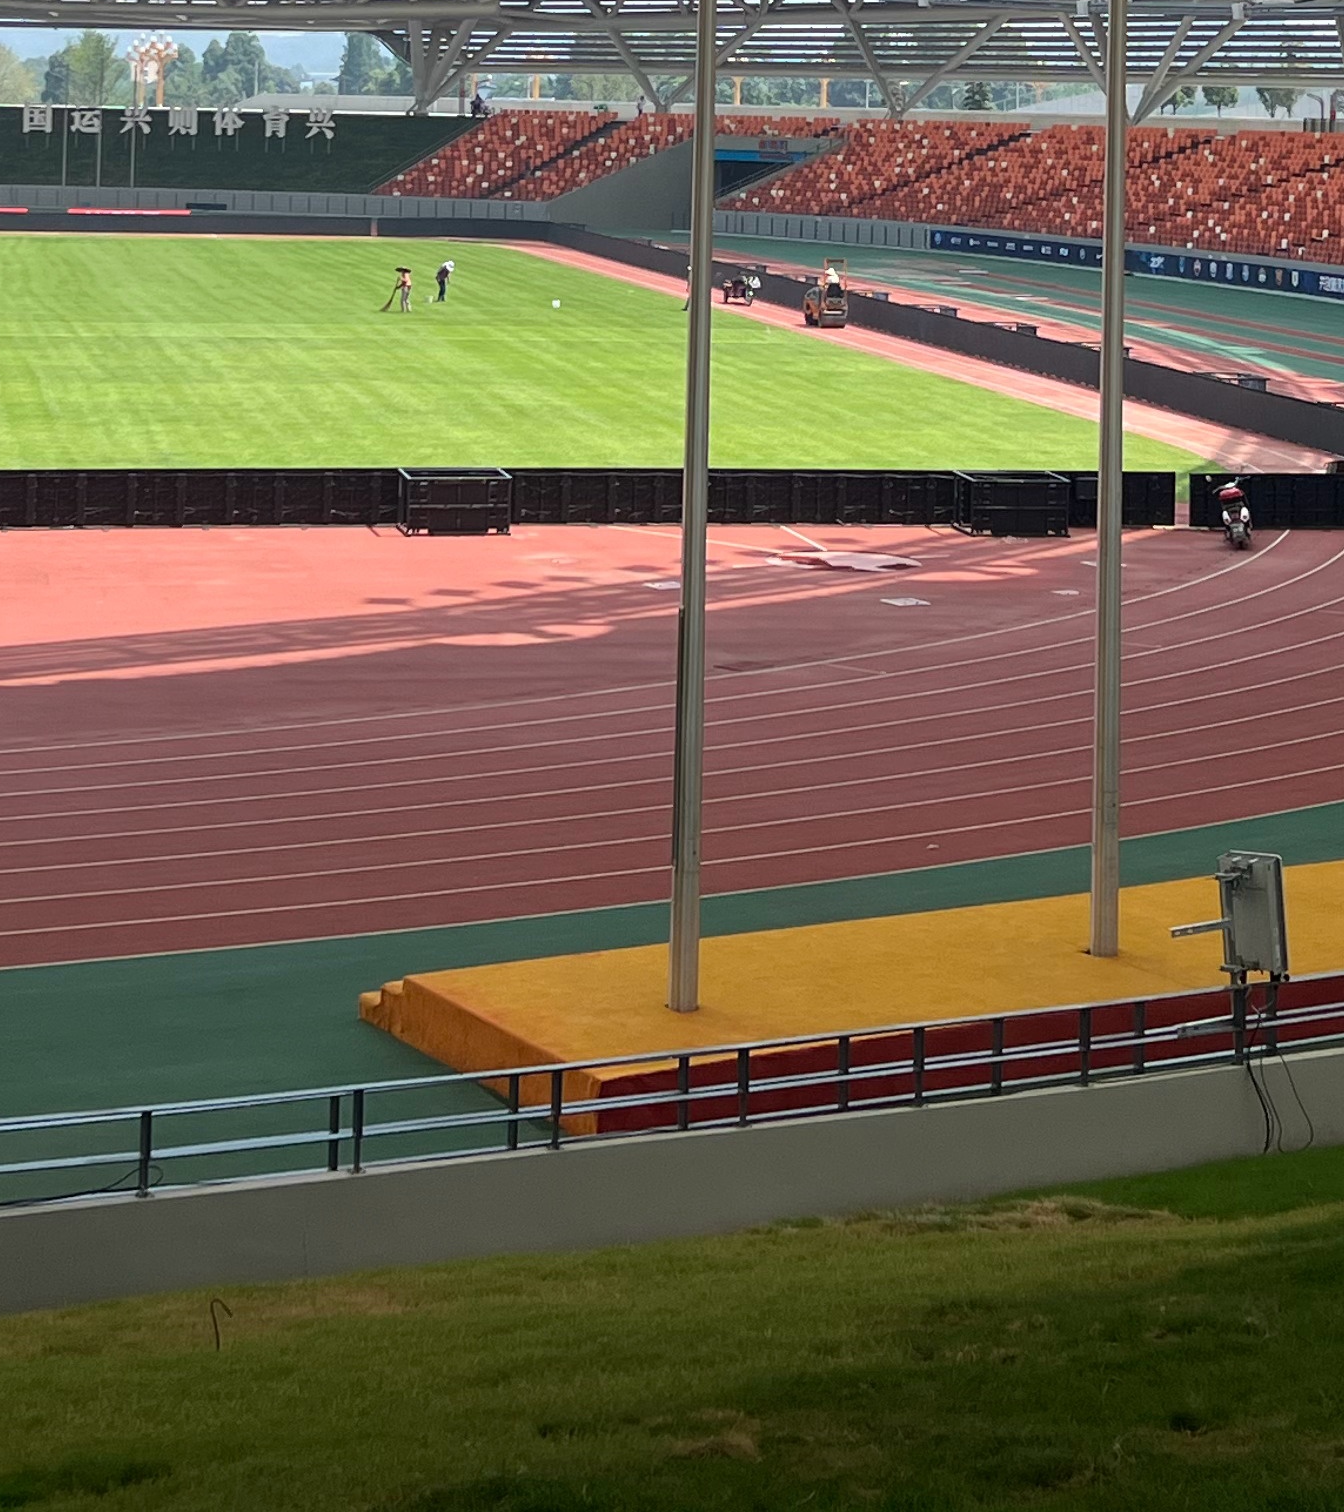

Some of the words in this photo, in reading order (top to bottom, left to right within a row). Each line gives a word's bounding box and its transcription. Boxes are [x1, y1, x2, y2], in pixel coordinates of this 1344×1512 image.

[22, 104, 337, 139] 国运兴则体育兴
